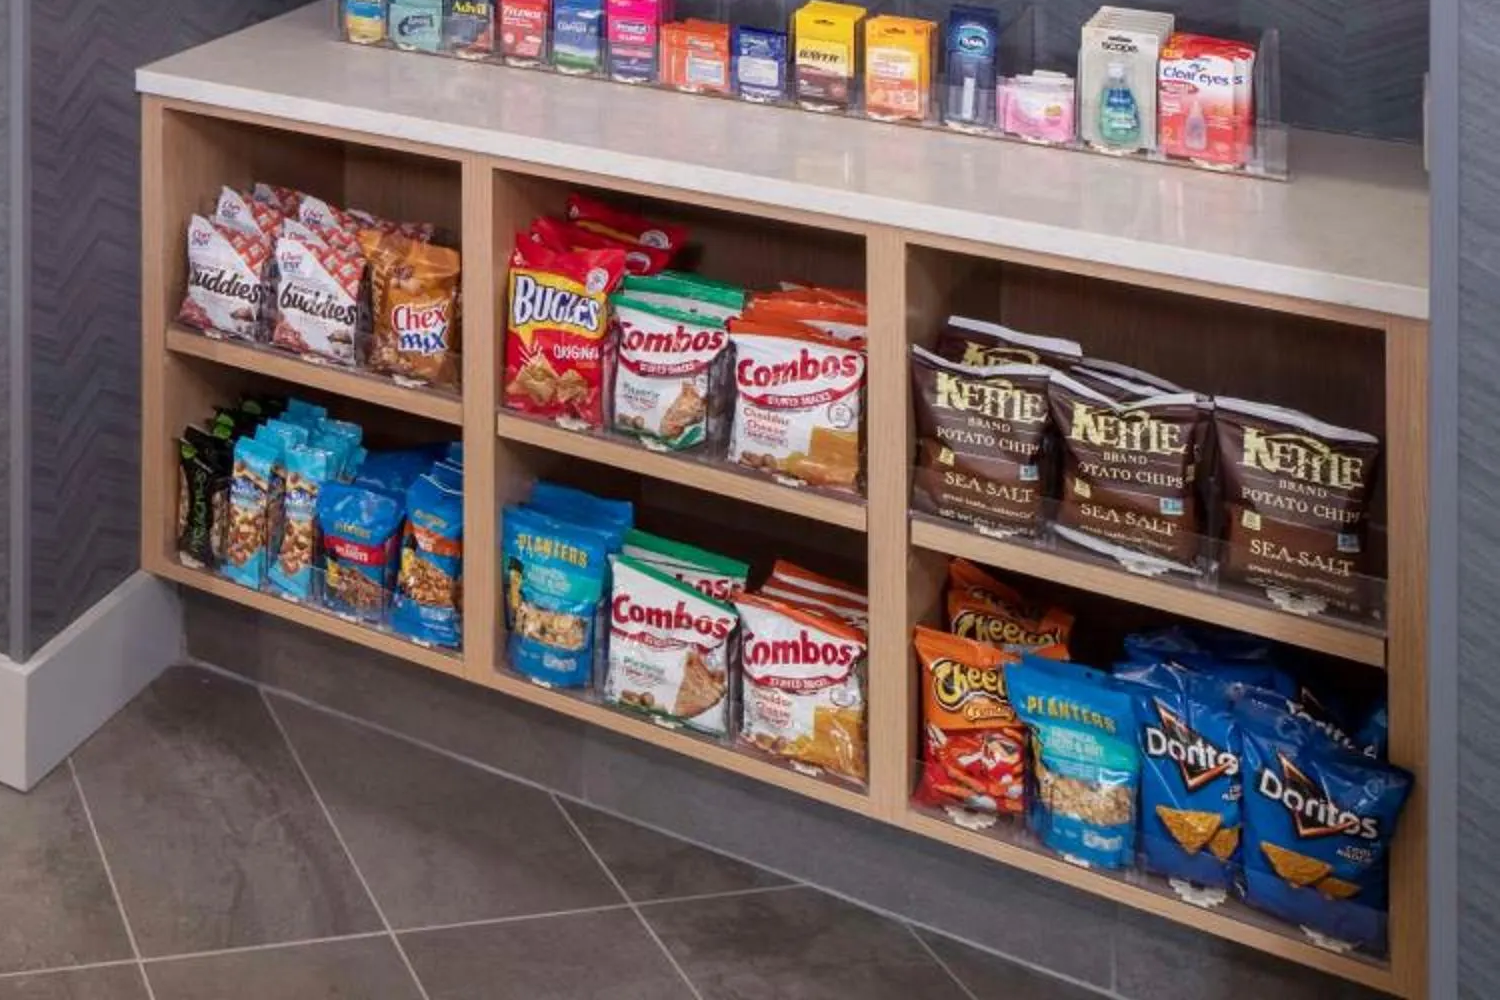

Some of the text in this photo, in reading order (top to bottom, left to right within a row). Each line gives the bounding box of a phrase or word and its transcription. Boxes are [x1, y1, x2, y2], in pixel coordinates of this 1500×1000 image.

[452, 0, 488, 16] Advil
[1163, 66, 1229, 86] Clear eyes
[280, 282, 357, 325] buddies
[391, 303, 448, 331] Chex
[512, 275, 601, 330] BUGLES
[737, 348, 858, 388] Combos
[936, 427, 996, 448] POTATO
[967, 415, 1012, 433] BRAND
[1102, 450, 1149, 466] BRAND
[1237, 425, 1365, 490] KETTLE
[944, 470, 1036, 503] SEA SALT
[1135, 469, 1184, 489] CHIPS
[1279, 479, 1328, 498] BRAND
[1242, 486, 1308, 512] POTATO
[1080, 503, 1178, 537] SEA SALT
[1250, 539, 1355, 576] SEA SALT
[612, 593, 731, 640] Combos
[1026, 694, 1117, 733] PLANTERS
[1146, 726, 1239, 776] Dorito
[1259, 768, 1378, 839] Doritos
